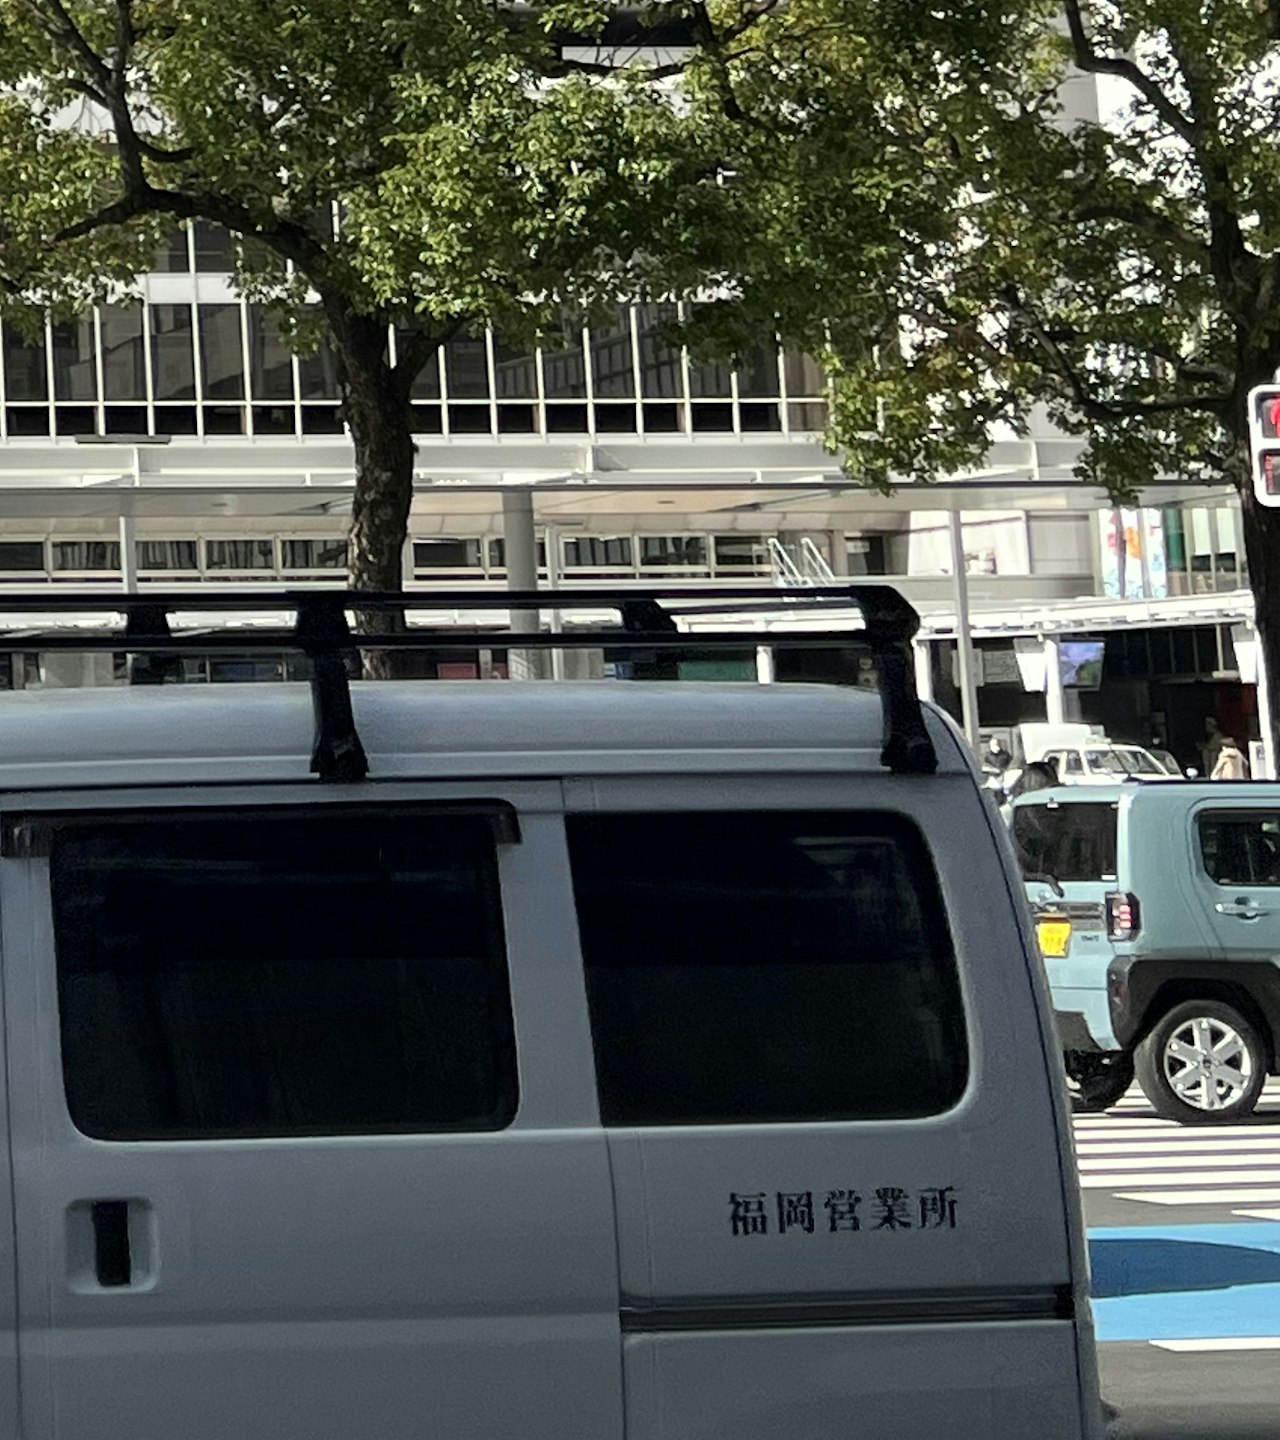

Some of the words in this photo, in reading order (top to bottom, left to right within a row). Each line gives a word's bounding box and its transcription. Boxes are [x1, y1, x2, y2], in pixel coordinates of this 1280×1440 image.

[730, 1185, 959, 1236] 福岡営業所
